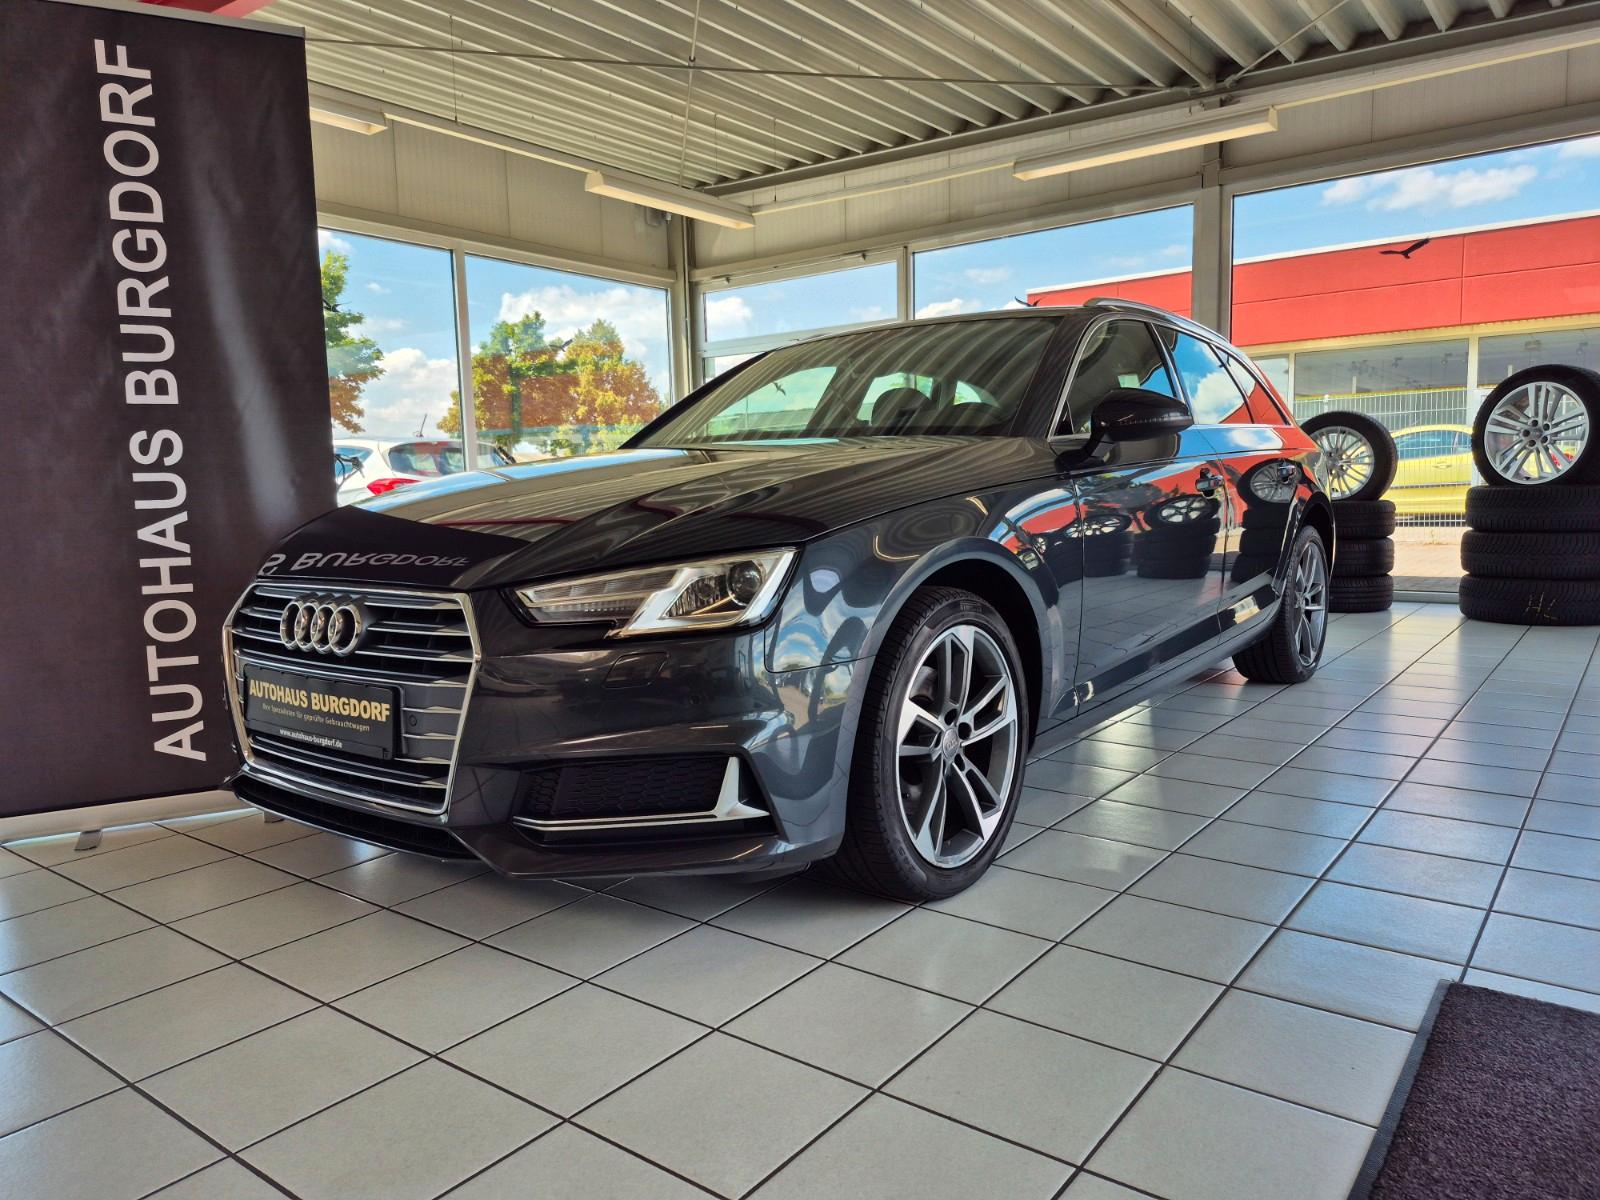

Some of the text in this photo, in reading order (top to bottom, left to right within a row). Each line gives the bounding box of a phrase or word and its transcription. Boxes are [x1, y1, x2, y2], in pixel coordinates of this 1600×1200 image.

[94, 38, 207, 762] AUTOHAUS BURGDORF
[249, 680, 390, 722] AUTOHAUS BURGDORF
[279, 728, 343, 749] www.autohaus-burgdorf.de
[325, 716, 370, 732] Gebrauchtwagen
